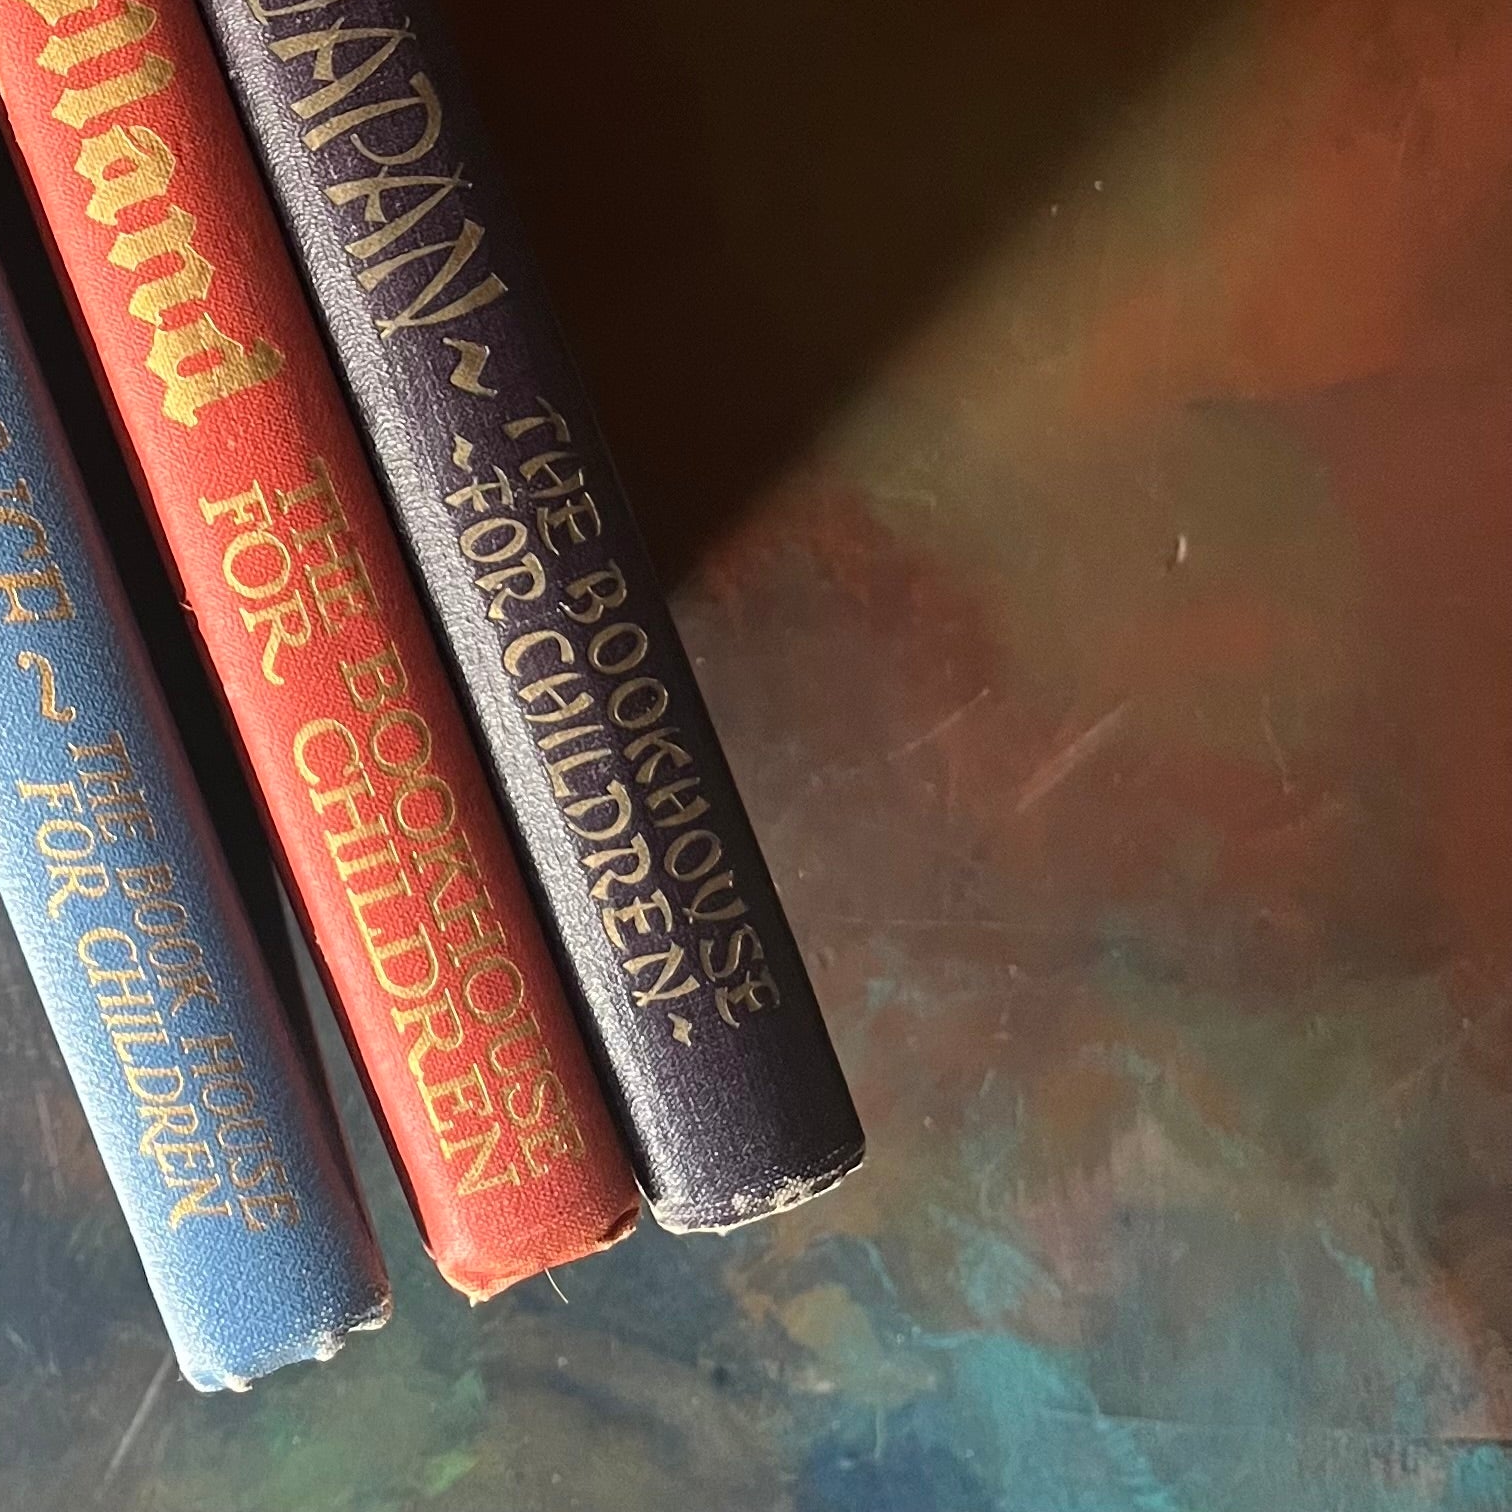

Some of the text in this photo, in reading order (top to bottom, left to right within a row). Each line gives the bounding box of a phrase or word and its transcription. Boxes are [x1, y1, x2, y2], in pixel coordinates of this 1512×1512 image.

[444, 463, 700, 1015] FOR CHILDREN
[495, 398, 607, 559] THE
[15, 776, 232, 1231] FOR CHILDREN
[68, 731, 303, 1233] THE BOOK HOUSE
[197, 480, 521, 1205] FOR CHILDREN
[271, 457, 589, 1179] THE BOOKHOUSE
